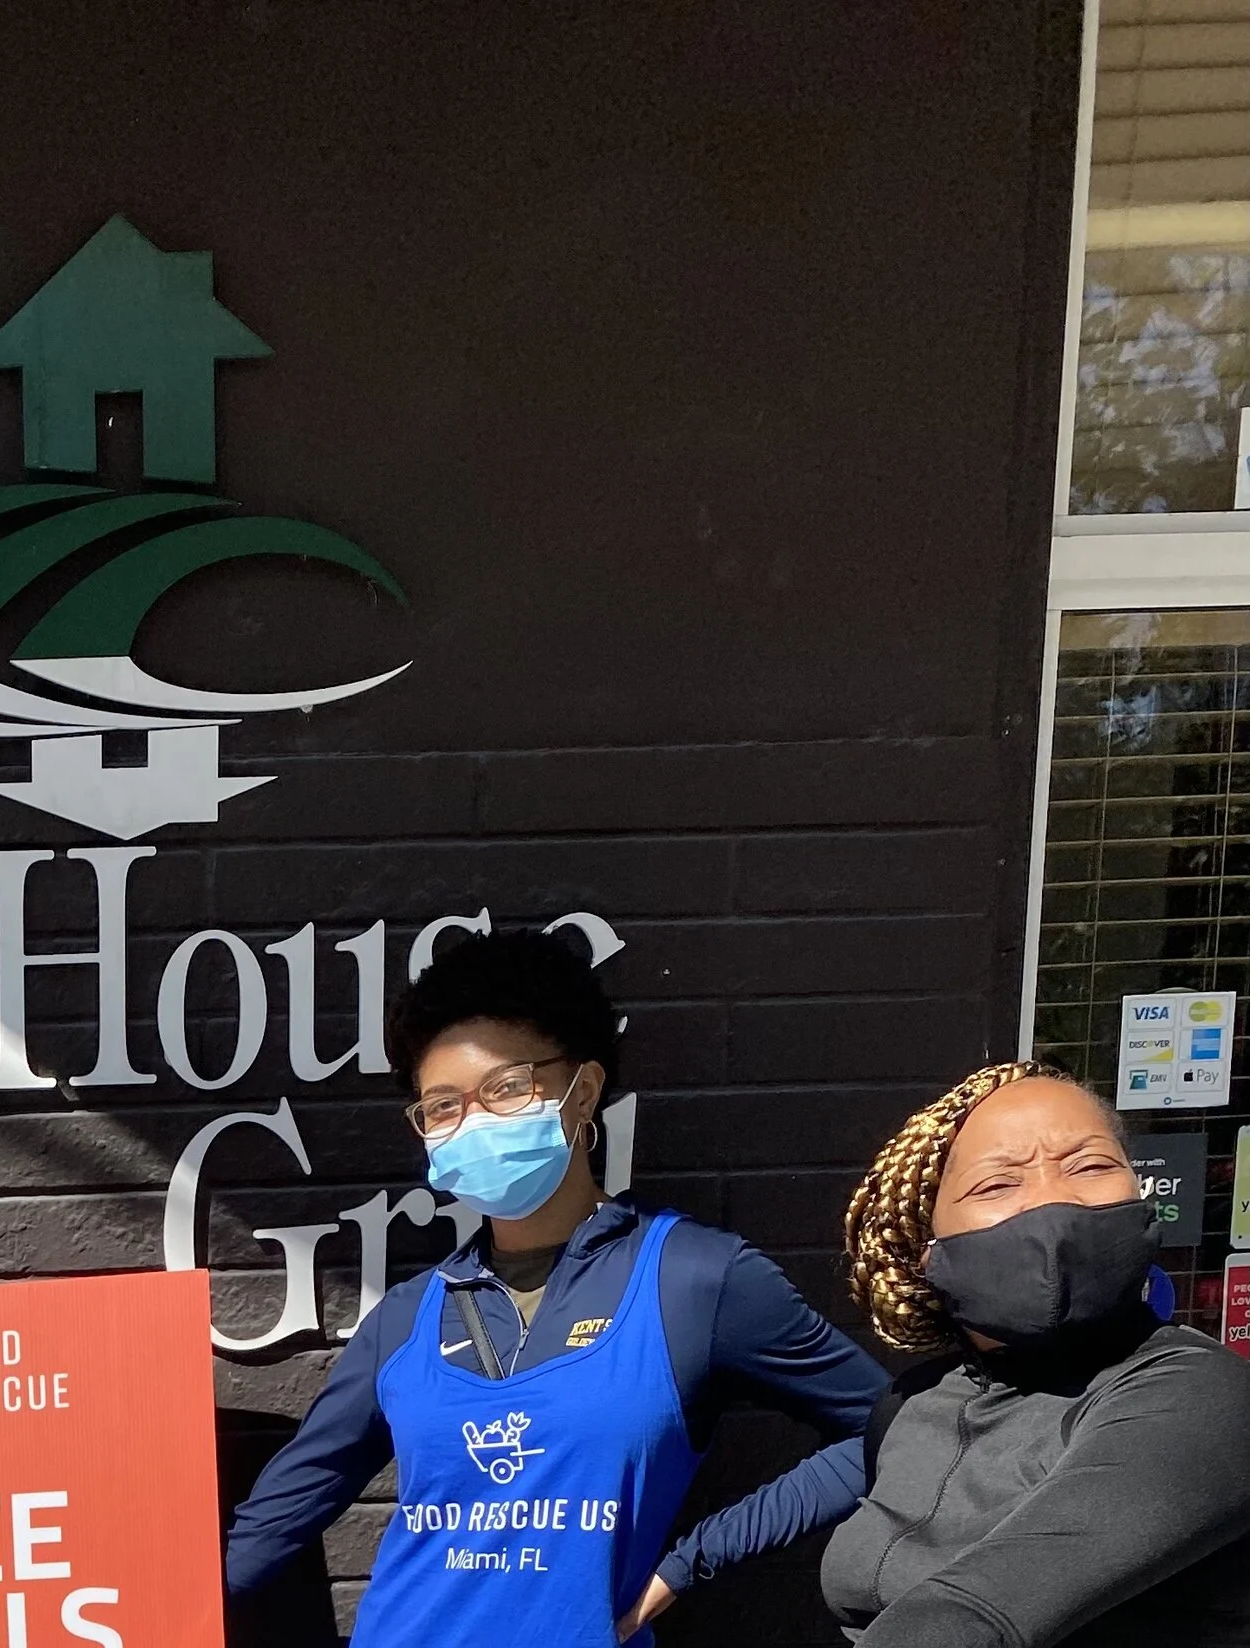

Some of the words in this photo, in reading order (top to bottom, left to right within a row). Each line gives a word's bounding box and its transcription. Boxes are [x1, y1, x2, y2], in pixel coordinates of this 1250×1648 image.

[1132, 1006, 1170, 1021] VISA
[1128, 1040, 1171, 1049] DISCOVER
[1196, 1068, 1220, 1085] Pay
[1147, 1158, 1166, 1167] with
[1154, 1201, 1180, 1222] ts
[569, 1318, 605, 1337] KENT
[402, 1502, 461, 1534] FOOD
[467, 1498, 568, 1532] RESCUE
[579, 1500, 618, 1532] US
[519, 1548, 549, 1571] FL
